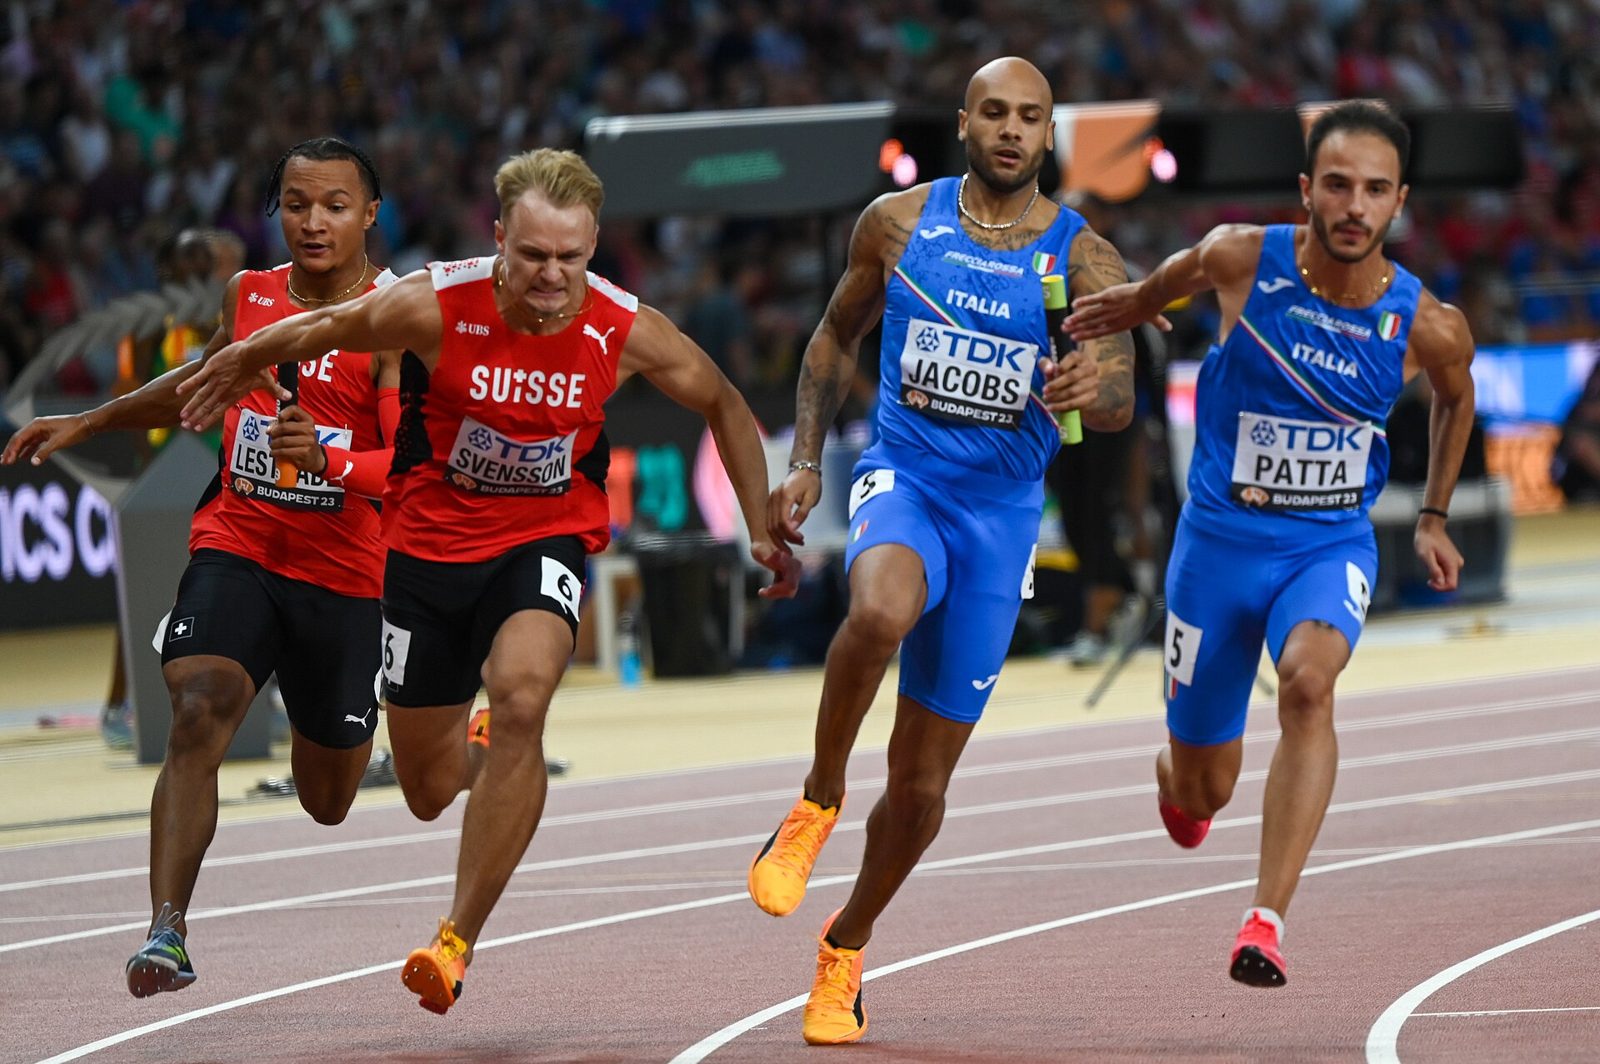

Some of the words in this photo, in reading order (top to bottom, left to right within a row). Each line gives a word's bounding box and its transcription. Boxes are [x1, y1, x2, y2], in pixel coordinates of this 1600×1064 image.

[258, 296, 275, 307] UBS
[946, 289, 1011, 319] ITALIA
[468, 324, 490, 335] UBS
[942, 330, 1027, 373] TDK
[1291, 342, 1358, 379] ITALIA
[908, 359, 1021, 406] JACOBS
[930, 399, 998, 423] BUDAPEST
[495, 435, 566, 463] TDK
[1278, 423, 1366, 452] TDK
[456, 447, 566, 484] SVENSSON
[1255, 454, 1348, 487] PATTA
[257, 485, 320, 506] BUDAPEST
[321, 496, 335, 507] 23
[480, 484, 547, 495] BUDAPEST
[1272, 492, 1341, 506] BUDAPEST
[1342, 492, 1357, 505] 23
[557, 573, 573, 602] 6
[383, 632, 395, 671] 6
[1170, 627, 1184, 668] 5
